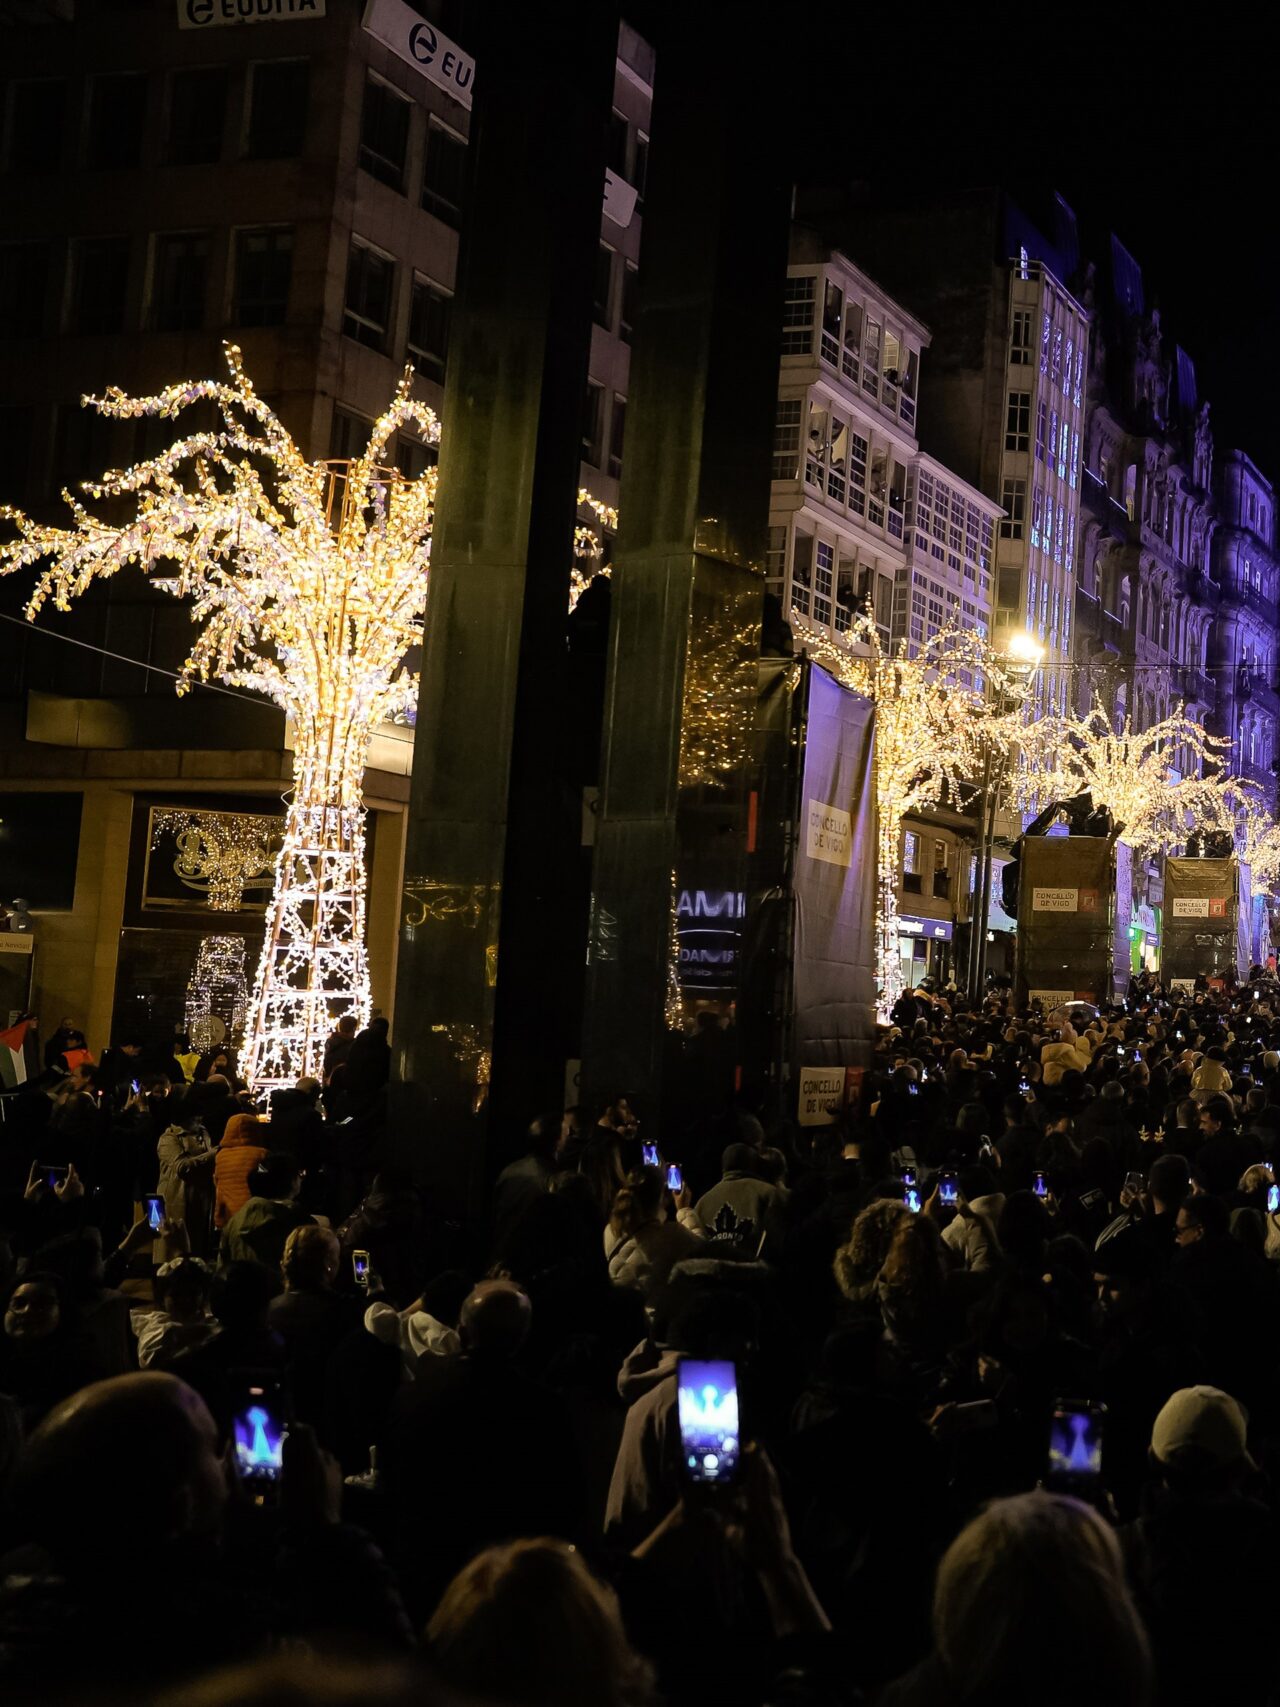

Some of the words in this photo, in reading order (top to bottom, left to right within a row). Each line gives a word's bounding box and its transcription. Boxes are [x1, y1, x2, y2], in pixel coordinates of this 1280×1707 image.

[811, 813, 847, 837] CONCELLO
[1036, 892, 1074, 900] CONCELLO
[803, 1080, 841, 1094] CONCELLO
[807, 1099, 816, 1113] DE
